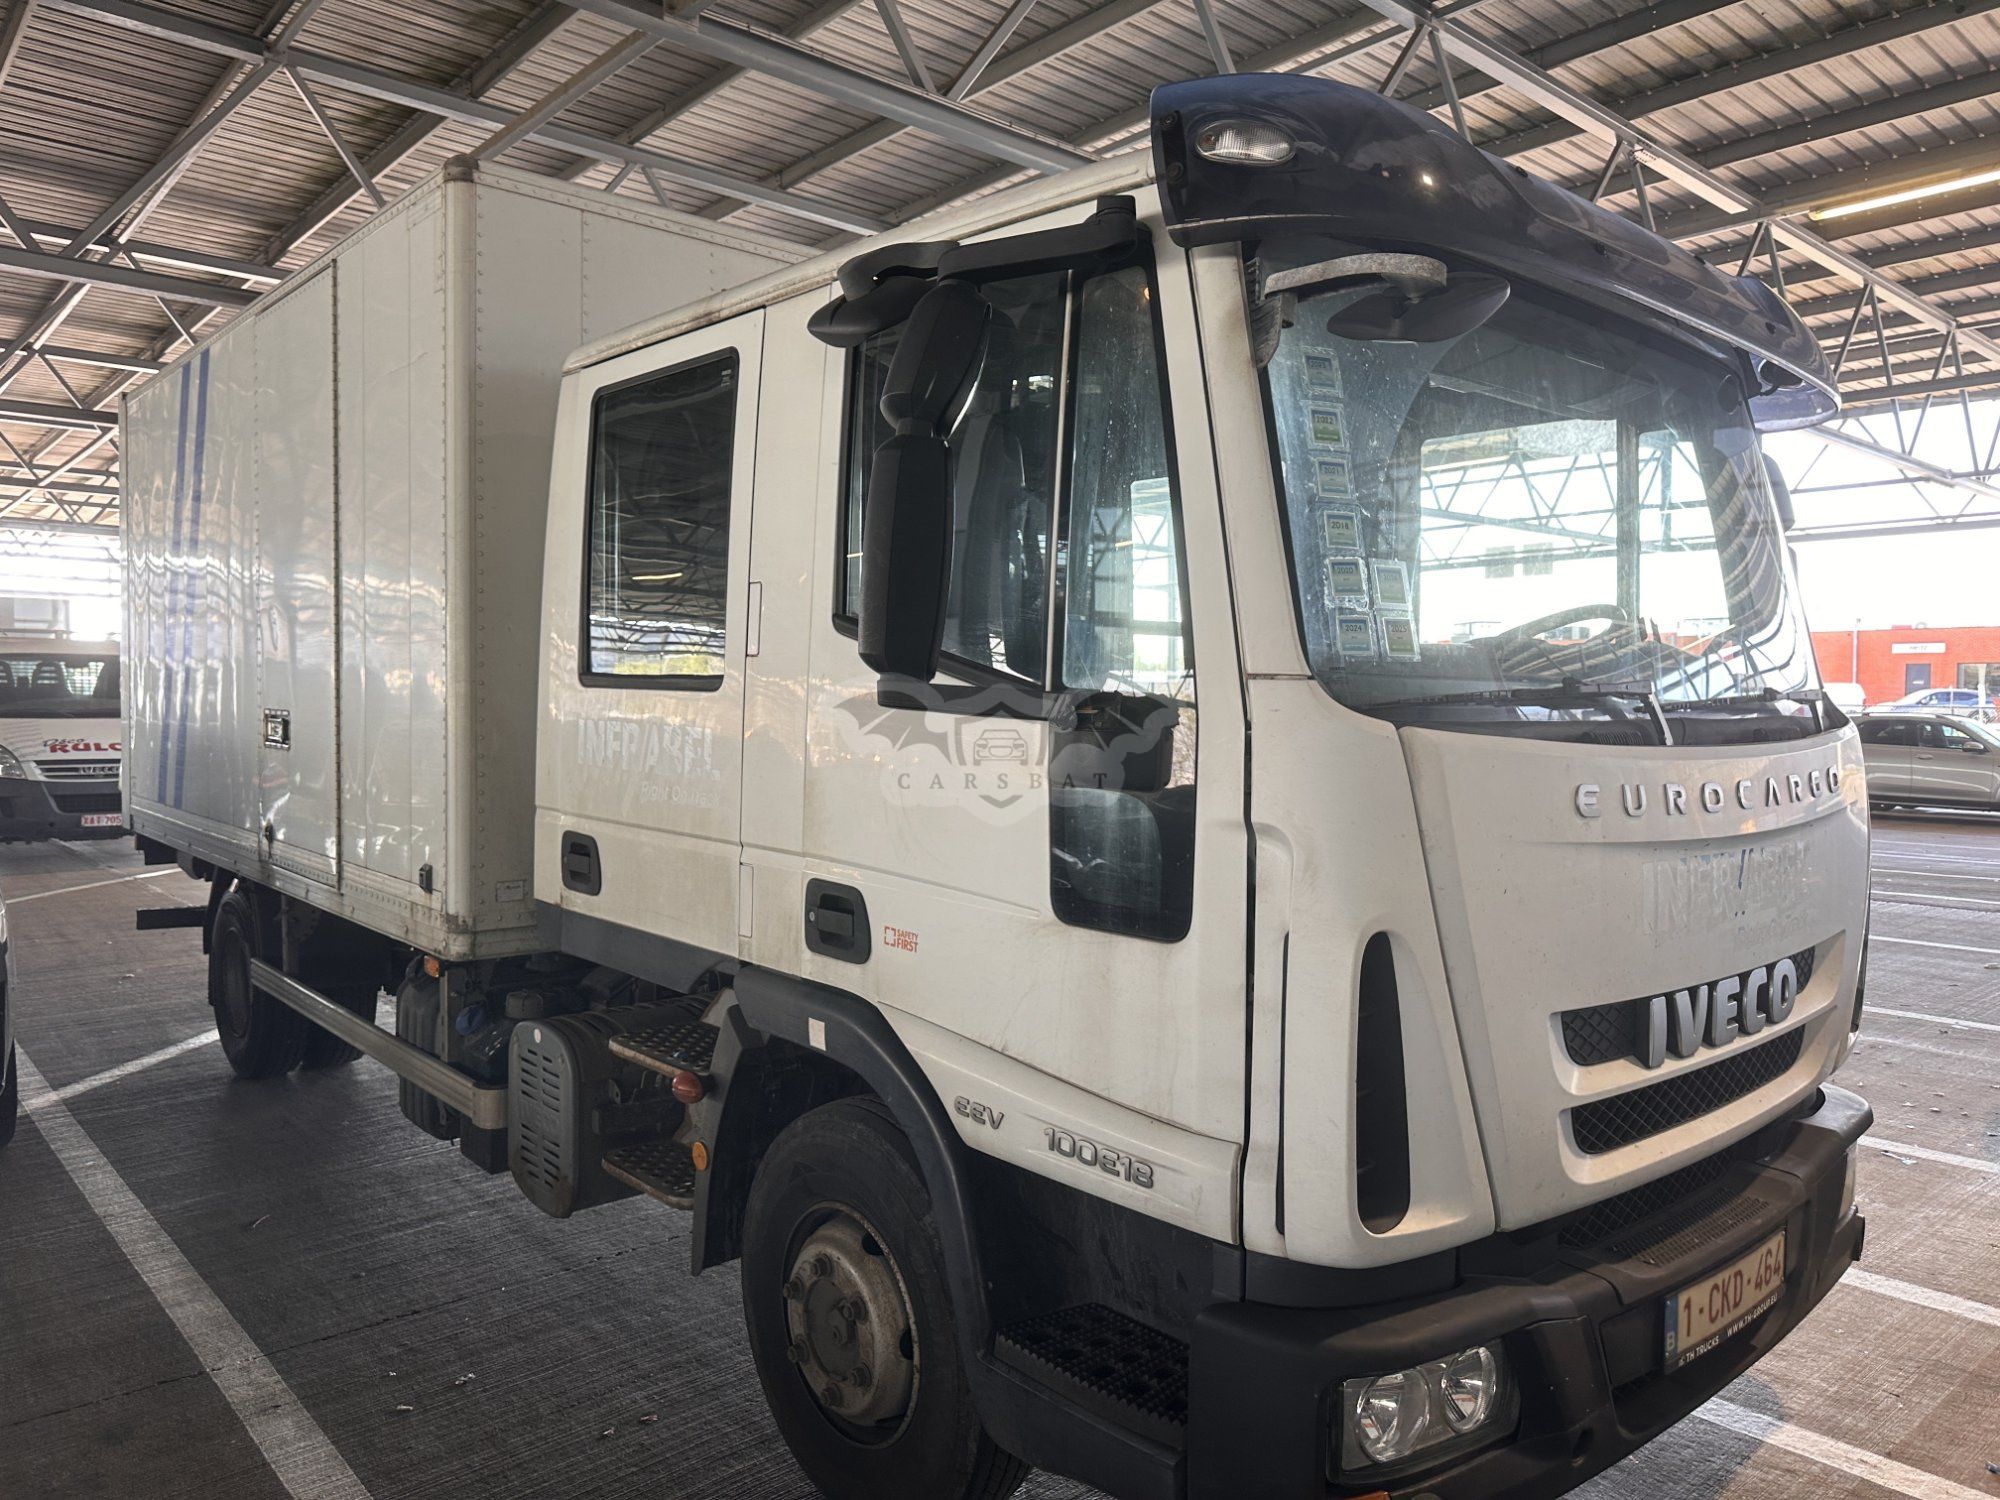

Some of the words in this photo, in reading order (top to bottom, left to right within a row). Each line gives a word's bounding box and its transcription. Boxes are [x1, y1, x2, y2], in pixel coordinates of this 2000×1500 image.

[1331, 520, 1349, 530] 2018
[1345, 624, 1362, 632] 2024
[1575, 764, 1840, 818] EUROCARGO
[896, 928, 919, 941] SAFETY
[896, 938, 919, 953] FIRST
[1649, 957, 1799, 1069] IVECO
[954, 1095, 1004, 1130] EEV
[1044, 1127, 1155, 1190] 100E18
[1695, 1335, 1720, 1357] TRUCKS
